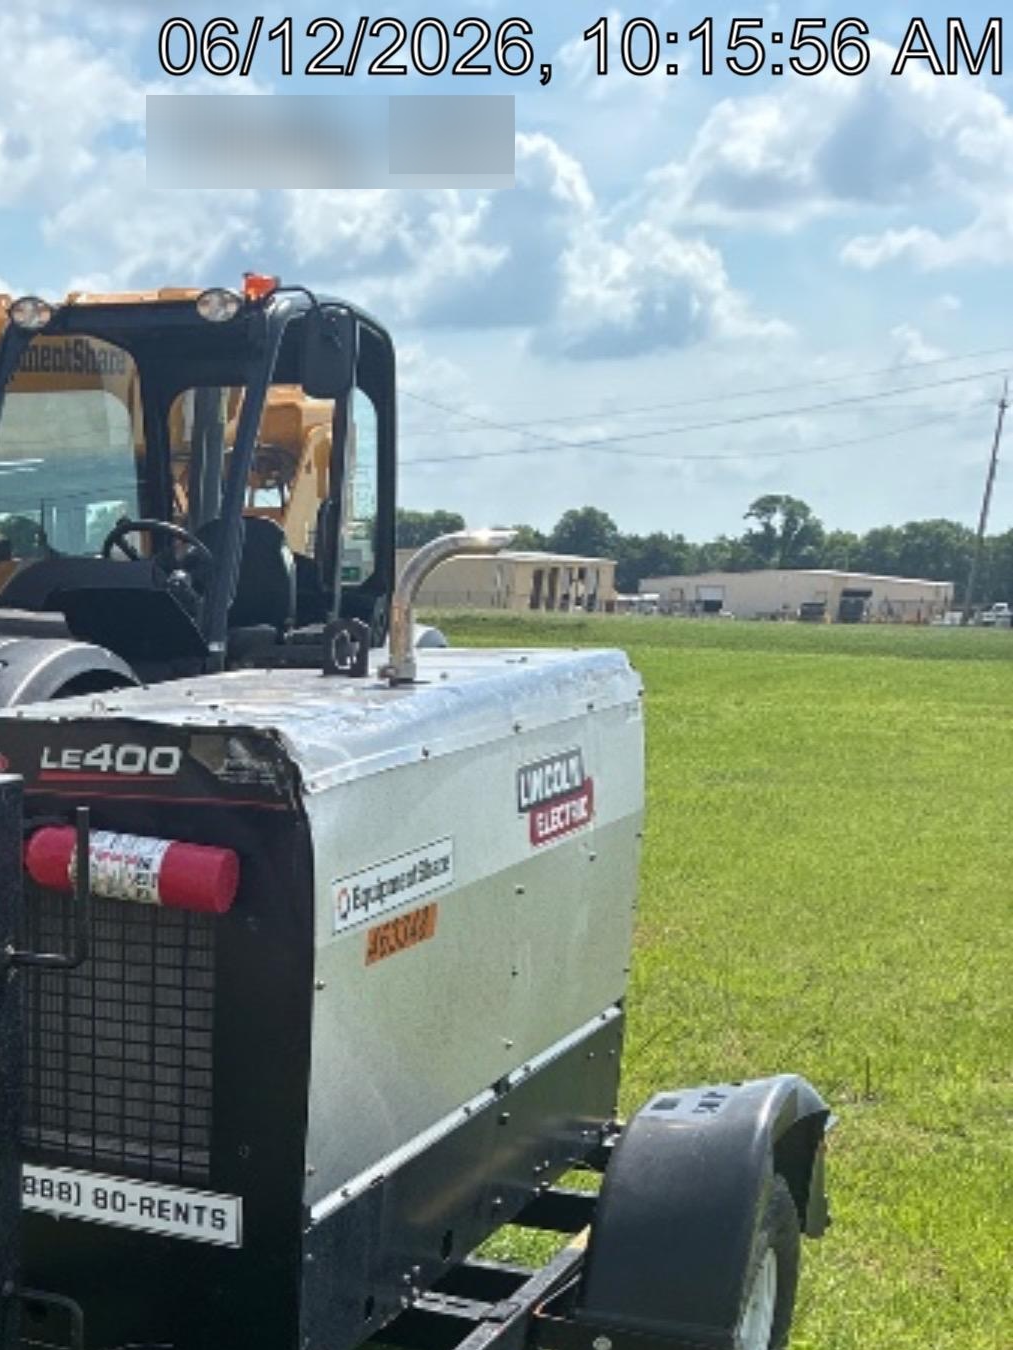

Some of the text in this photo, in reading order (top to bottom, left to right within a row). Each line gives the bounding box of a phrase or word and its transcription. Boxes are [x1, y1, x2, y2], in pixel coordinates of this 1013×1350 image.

[40, 743, 183, 776] LE400
[519, 753, 583, 809] LINCOLN
[91, 1187, 227, 1231] 80-RENTS
